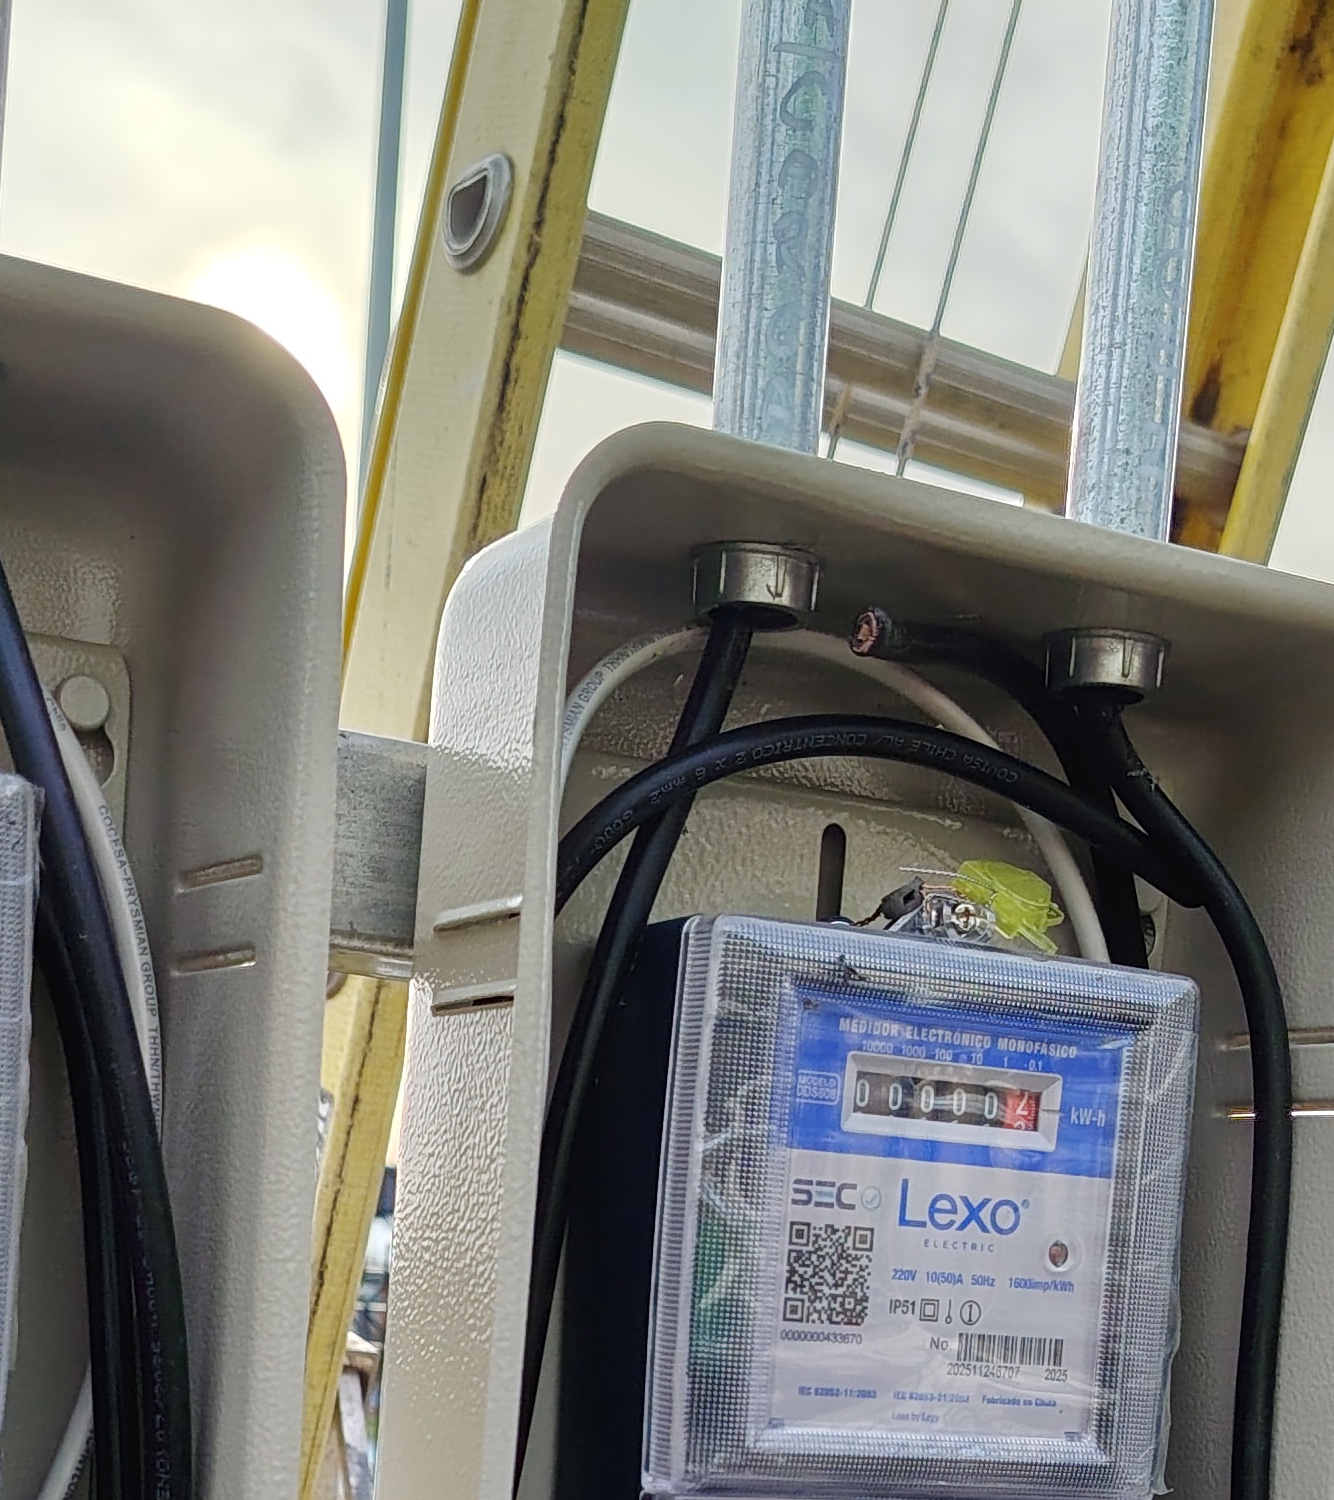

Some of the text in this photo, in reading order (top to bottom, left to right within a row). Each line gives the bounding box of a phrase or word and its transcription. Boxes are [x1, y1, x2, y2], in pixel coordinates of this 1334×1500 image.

[911, 737, 957, 764] CHILE
[141, 960, 158, 1018] GROUP
[838, 1016, 1077, 1058] MEDIDOR ELECTRÓNICO MONOFÁSICO
[1070, 1106, 1106, 1127] kW-h
[790, 1178, 858, 1211] SEC
[898, 1177, 1022, 1236] Lexo
[923, 1238, 995, 1253] ELECTRIC
[891, 1268, 917, 1283] 220V
[925, 1270, 964, 1286] 10(50)A
[970, 1273, 996, 1288] 50Hz
[888, 1298, 916, 1316] IP51
[1043, 1368, 1068, 1382] 2025
